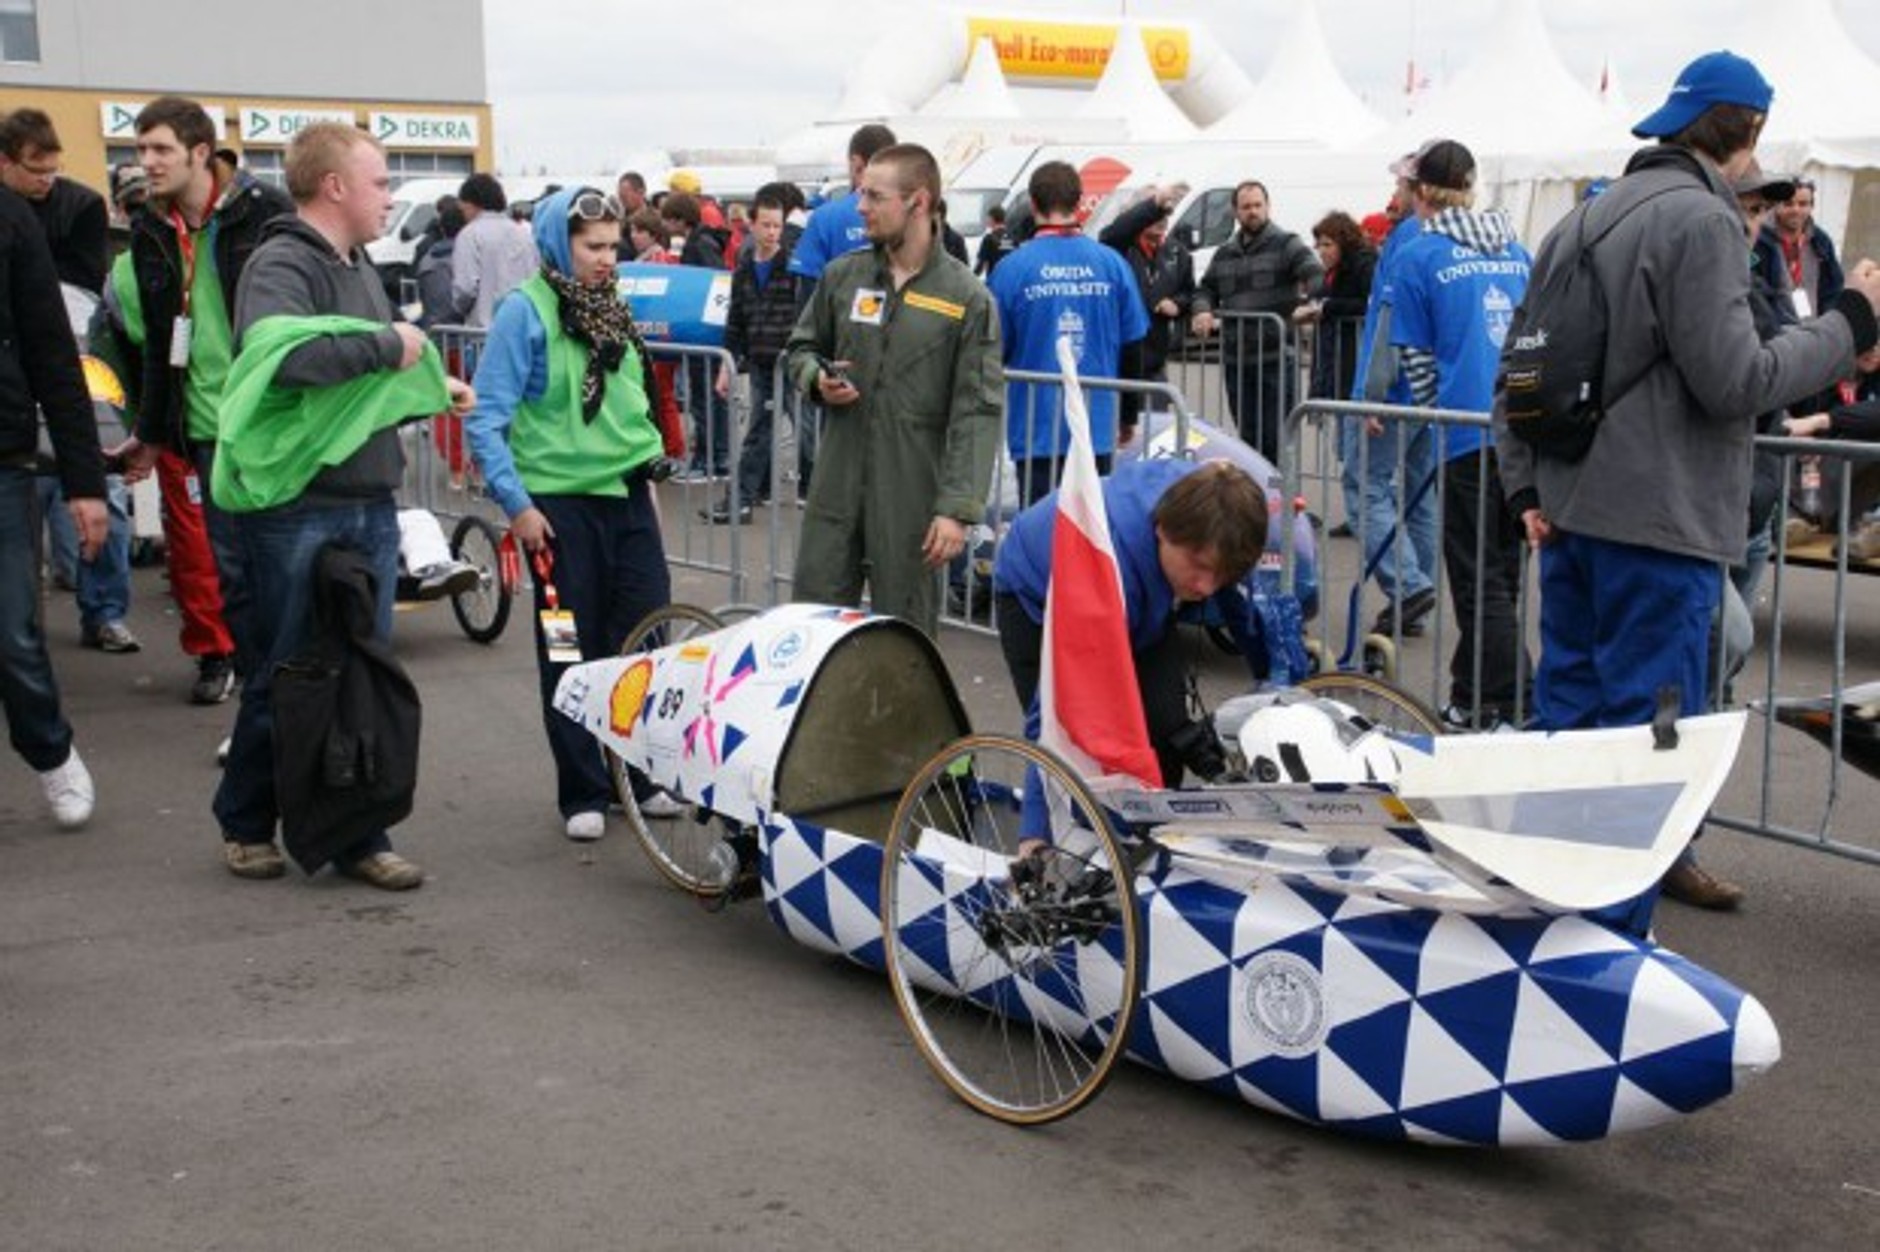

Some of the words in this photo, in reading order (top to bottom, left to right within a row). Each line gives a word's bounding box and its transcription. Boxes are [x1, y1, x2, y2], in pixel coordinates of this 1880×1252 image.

[993, 33, 1022, 60] hell
[1030, 36, 1111, 66] Eco-mara
[406, 119, 472, 139] DEKRA
[1025, 282, 1110, 300] UNIVERSITY
[657, 687, 684, 720] 89
